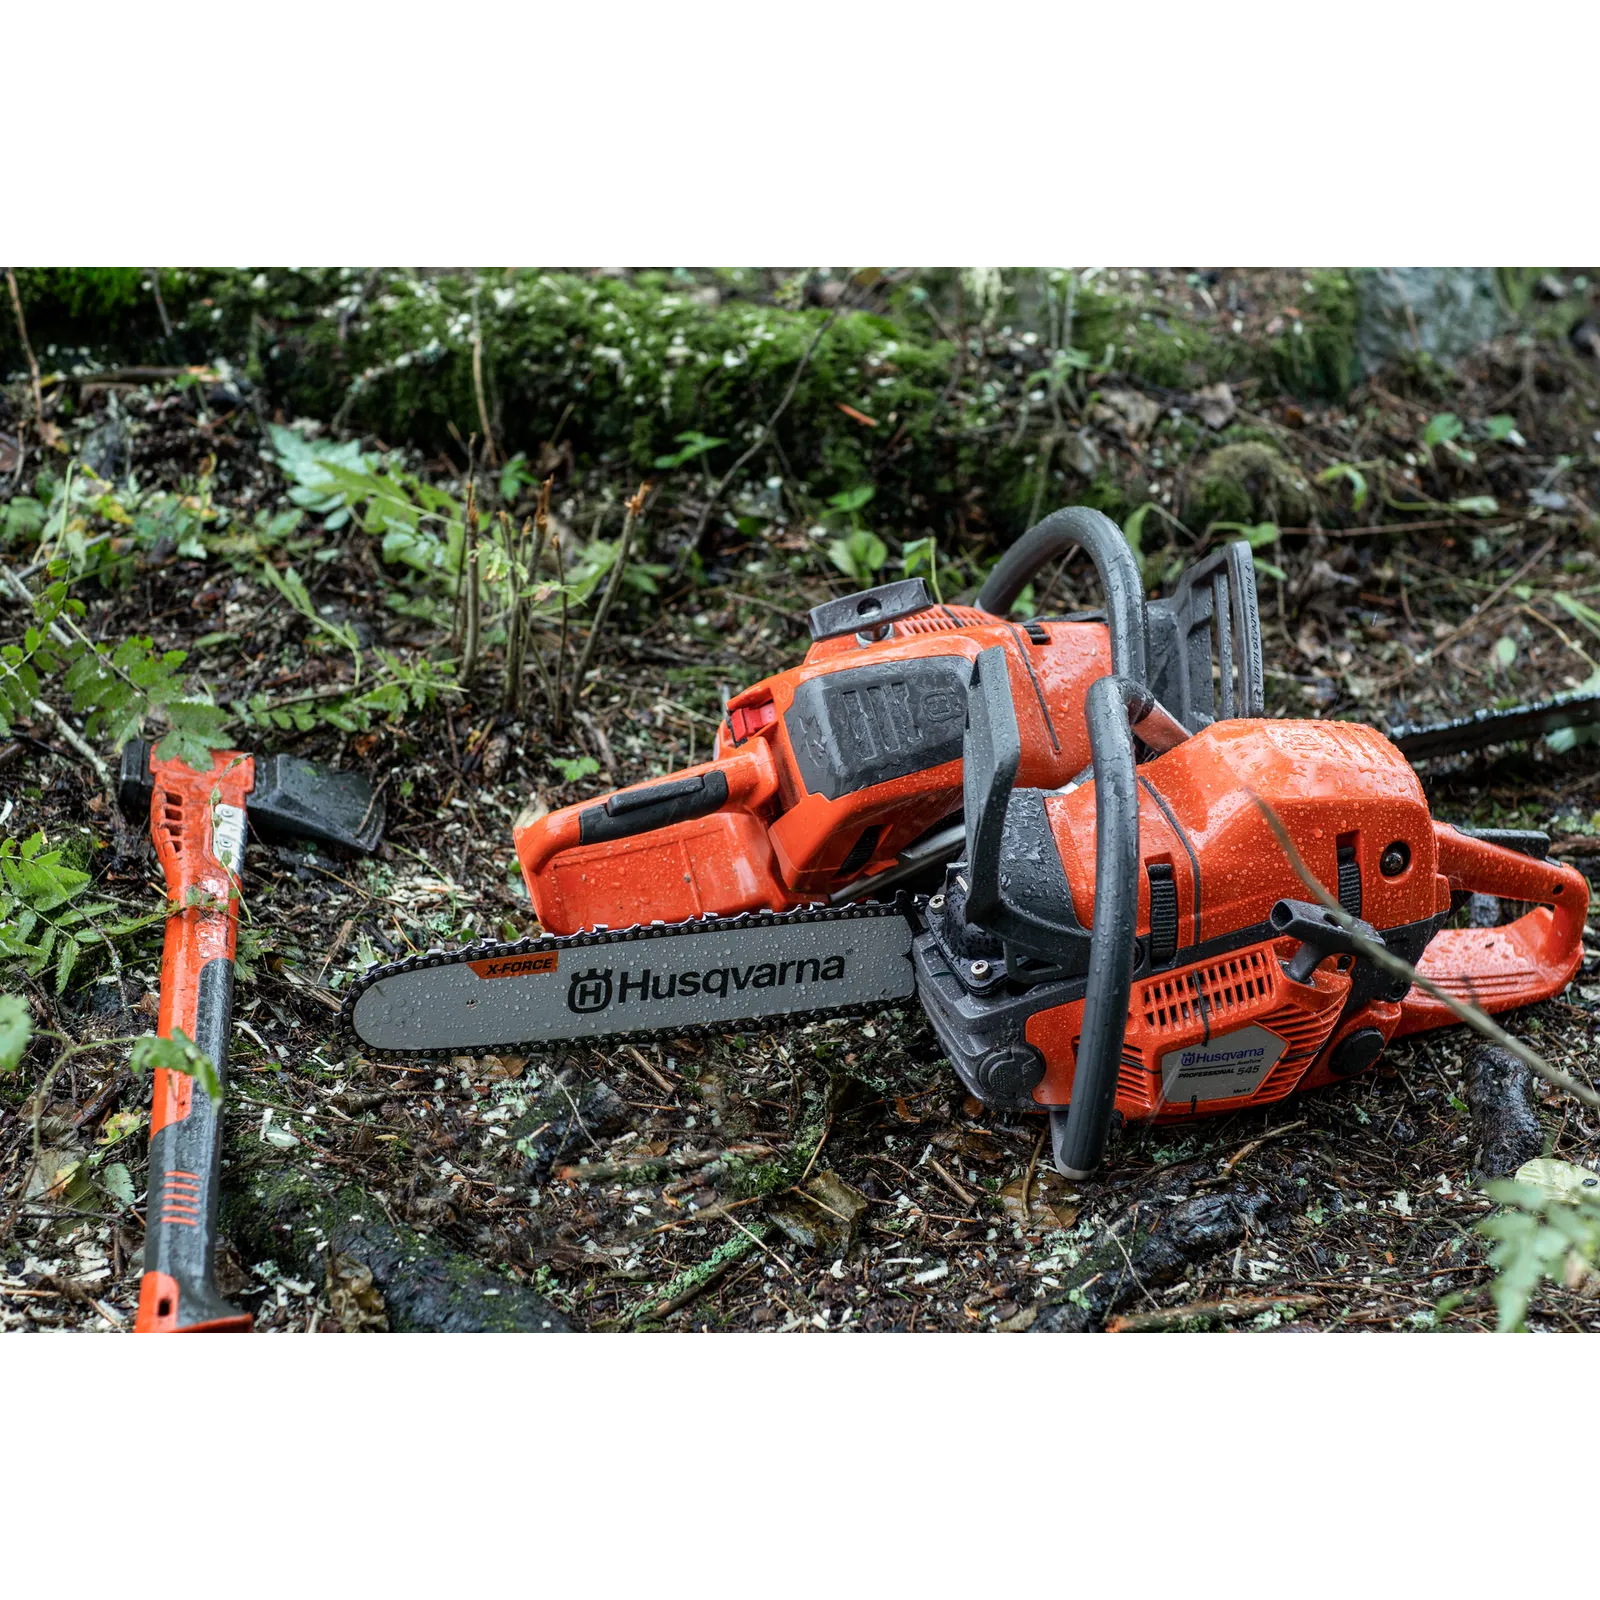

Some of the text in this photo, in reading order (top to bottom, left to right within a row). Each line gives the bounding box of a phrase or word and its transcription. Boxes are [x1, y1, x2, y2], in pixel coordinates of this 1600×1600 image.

[486, 958, 554, 976] X-FORCE
[618, 954, 845, 1004] Husqvarna
[1196, 1047, 1265, 1063] Husqvarna
[1178, 1065, 1260, 1079] PROFESSIONAL 545
